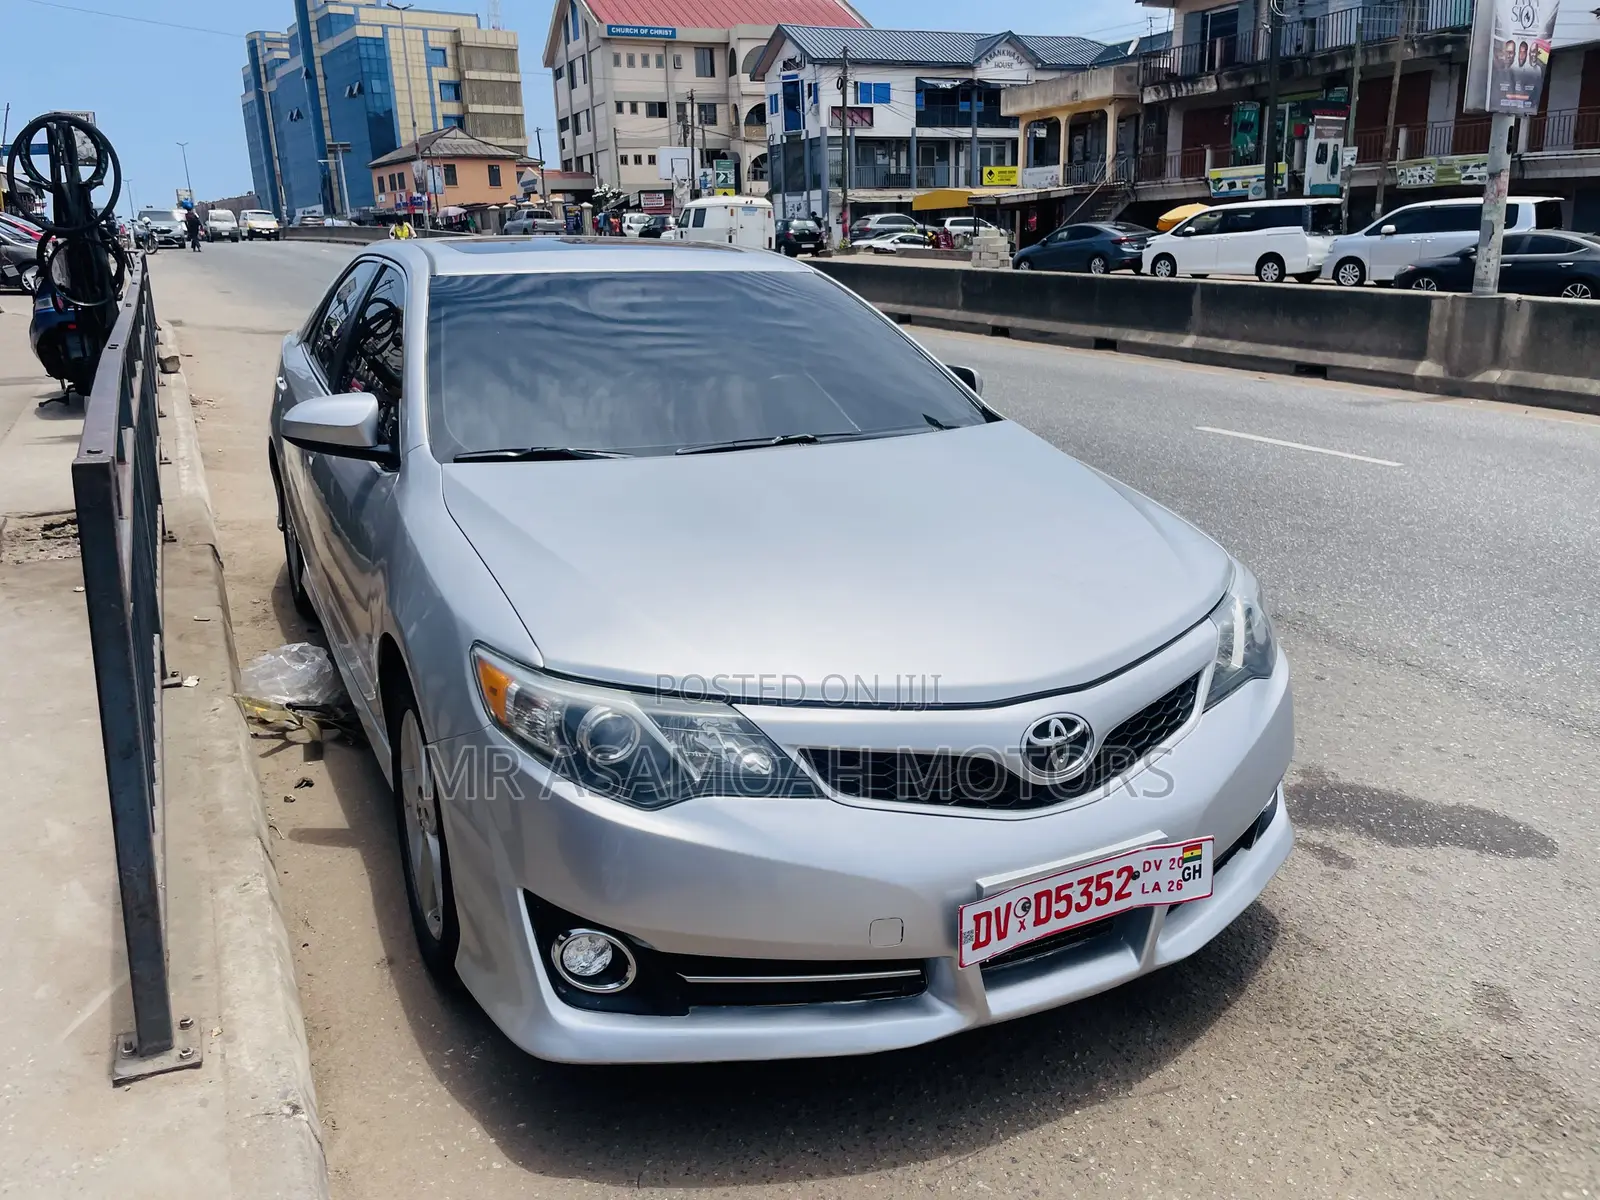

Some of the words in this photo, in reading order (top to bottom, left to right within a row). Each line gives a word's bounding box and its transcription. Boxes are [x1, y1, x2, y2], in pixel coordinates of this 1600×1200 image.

[994, 61, 1014, 69] HOUSE
[1142, 858, 1163, 873] DV
[1168, 855, 1184, 870] 20
[1181, 863, 1202, 882] GH
[1141, 880, 1162, 894] LA
[1167, 879, 1183, 893] 26
[971, 901, 1012, 951] DV
[1033, 865, 1134, 927] D5352
